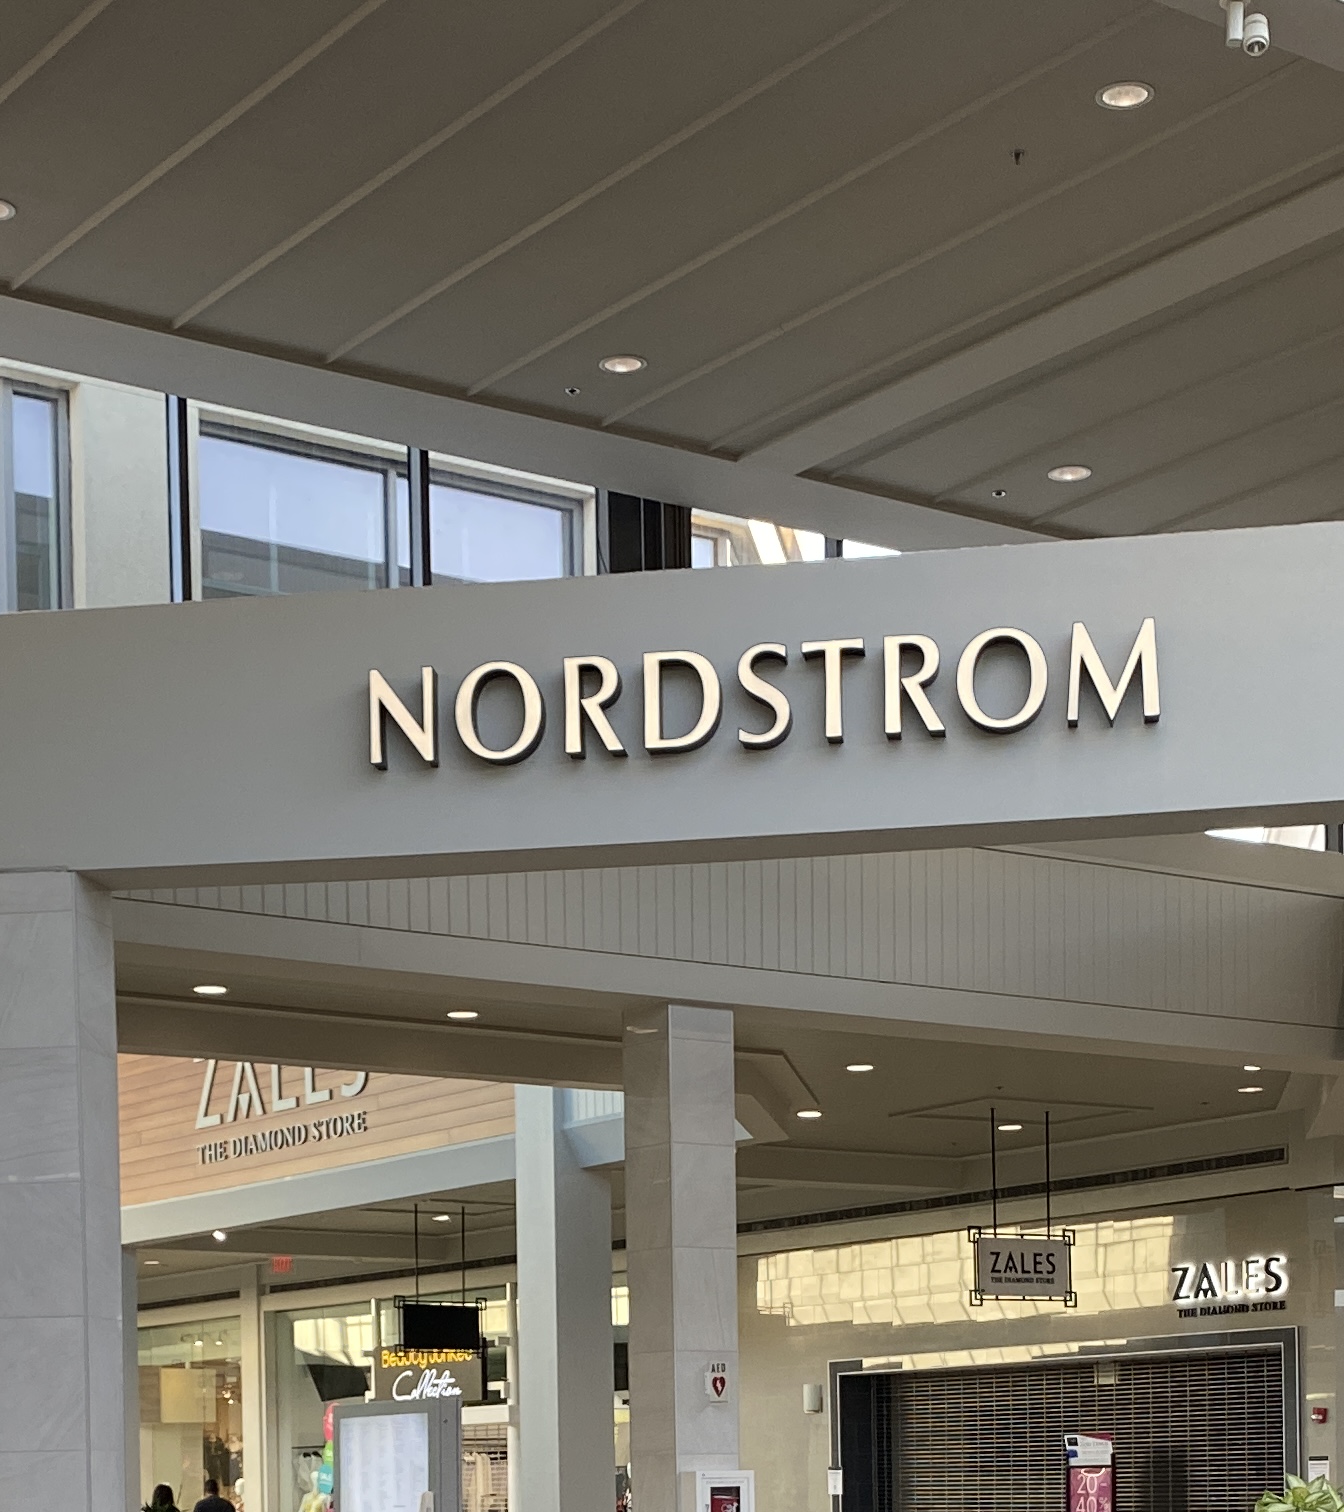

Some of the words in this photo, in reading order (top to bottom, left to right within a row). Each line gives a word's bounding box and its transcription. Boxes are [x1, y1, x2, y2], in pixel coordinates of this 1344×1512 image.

[368, 616, 1161, 770] NORDSTROM
[197, 1141, 229, 1165] THE
[230, 1123, 307, 1160] DIAMOND
[311, 1110, 368, 1143] STORE
[989, 1250, 1057, 1275] ZALES
[1171, 1256, 1284, 1301] ZALES
[1177, 1308, 1197, 1318] THE
[1199, 1303, 1250, 1316] DIAMOND
[1251, 1300, 1285, 1312] STORE
[392, 1368, 463, 1402] Collection
[711, 1362, 727, 1374] AED
